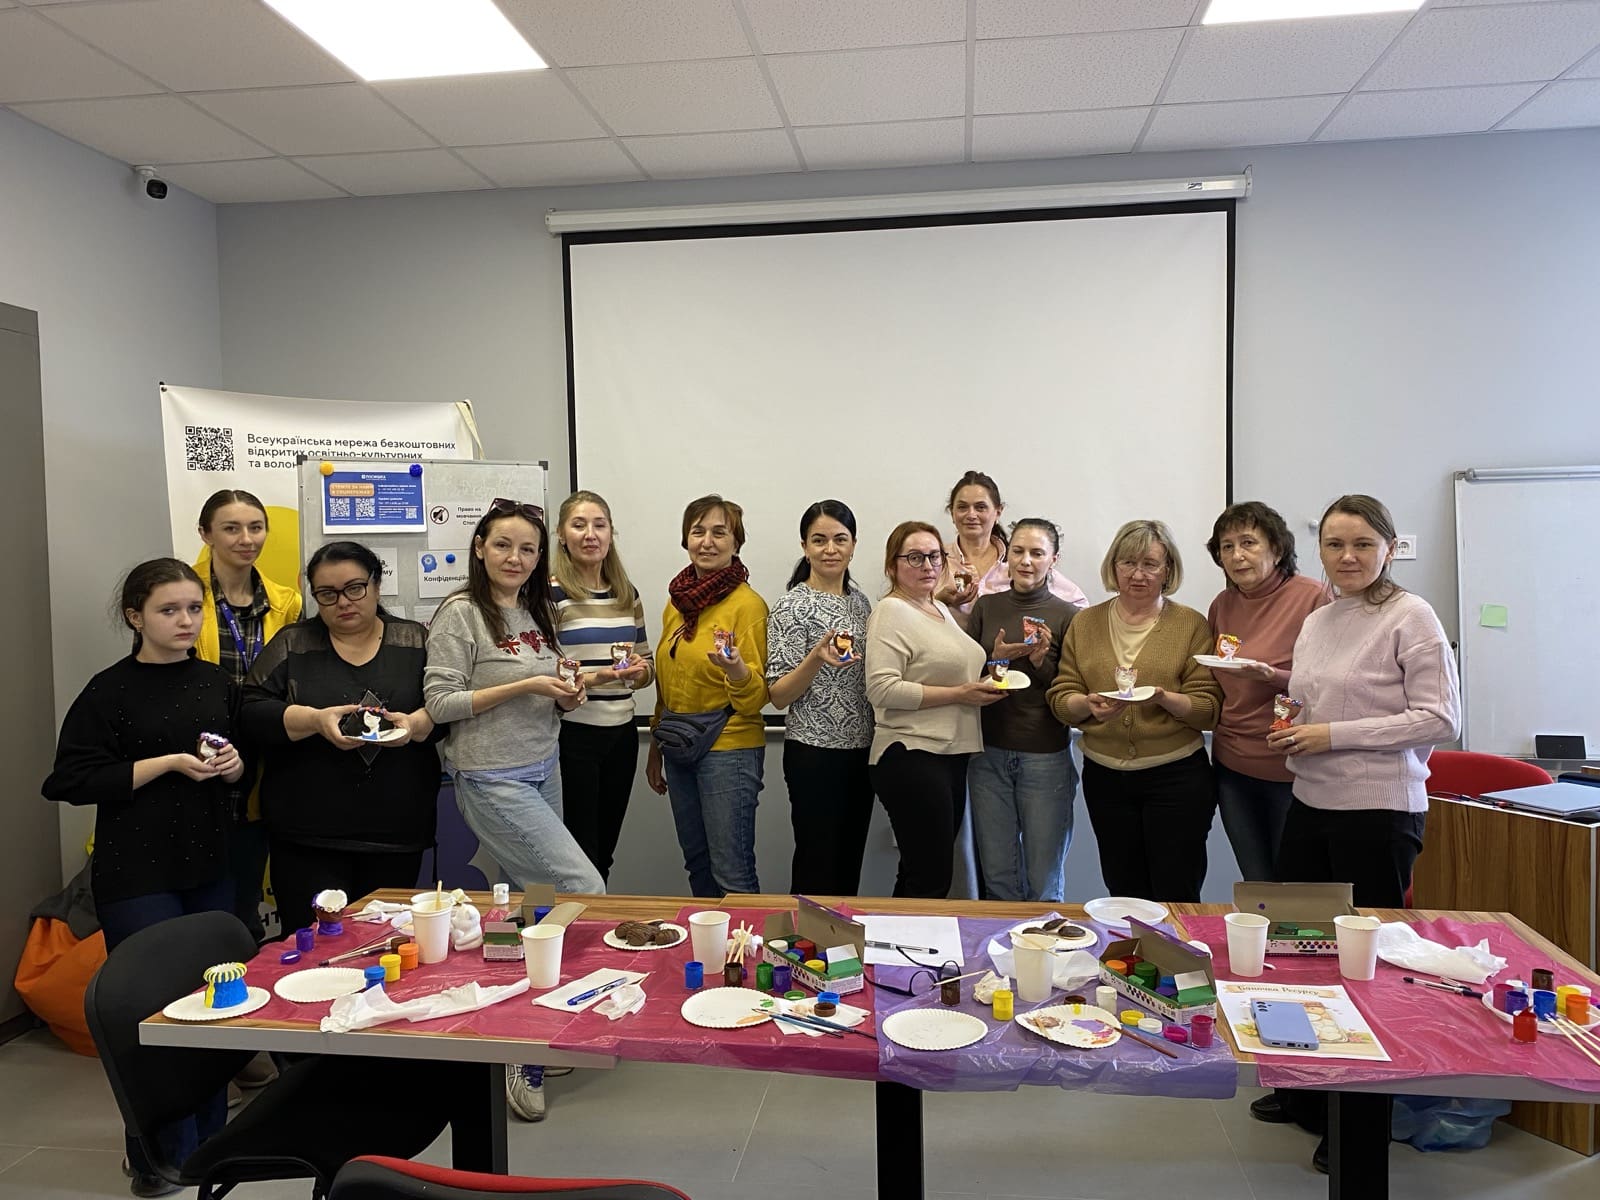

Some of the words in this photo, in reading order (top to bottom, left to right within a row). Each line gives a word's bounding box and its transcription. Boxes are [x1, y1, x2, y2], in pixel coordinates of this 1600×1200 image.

[247, 433, 332, 447] Всеукраїнська
[334, 439, 378, 449] мережа
[380, 438, 456, 449] безкоштовних
[247, 446, 305, 458] відкритих
[248, 460, 261, 468] та
